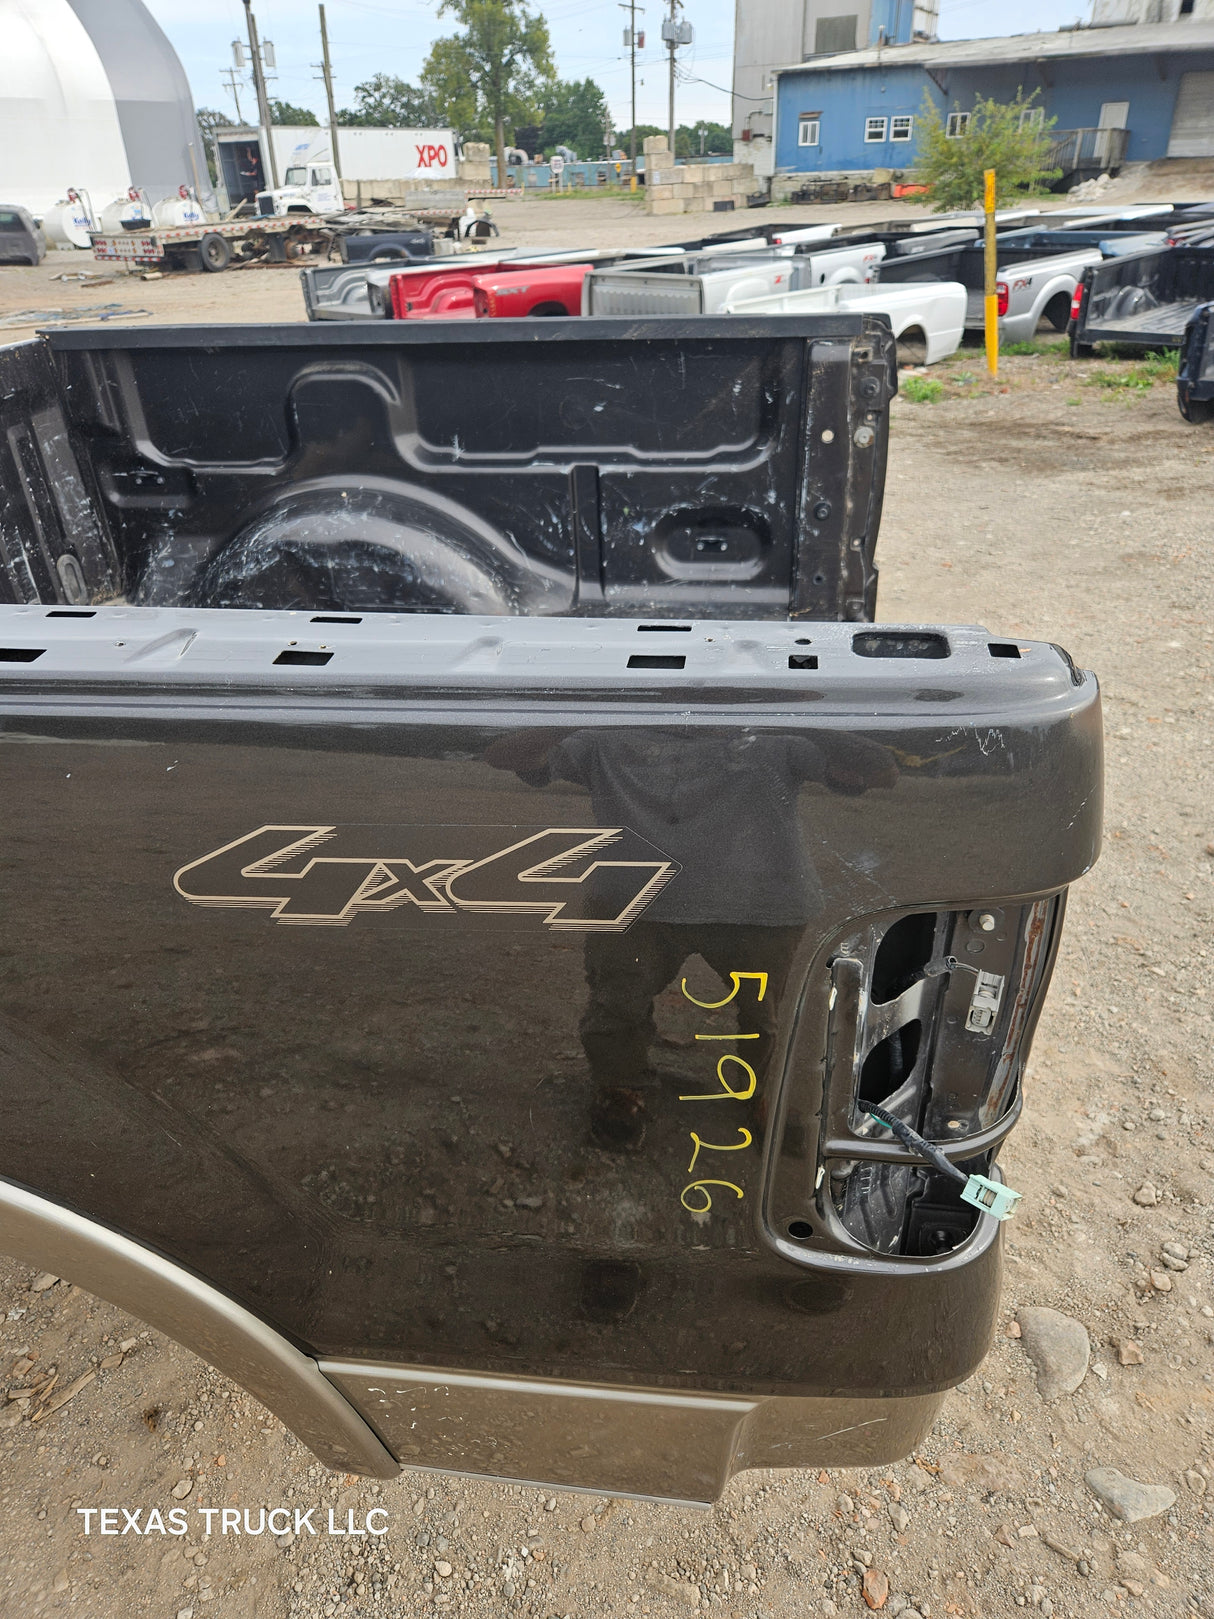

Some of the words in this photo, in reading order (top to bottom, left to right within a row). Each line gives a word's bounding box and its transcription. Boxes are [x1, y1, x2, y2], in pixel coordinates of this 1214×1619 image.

[415, 144, 448, 168] XPO
[172, 824, 678, 932] 4x4
[680, 971, 769, 1214] 51926
